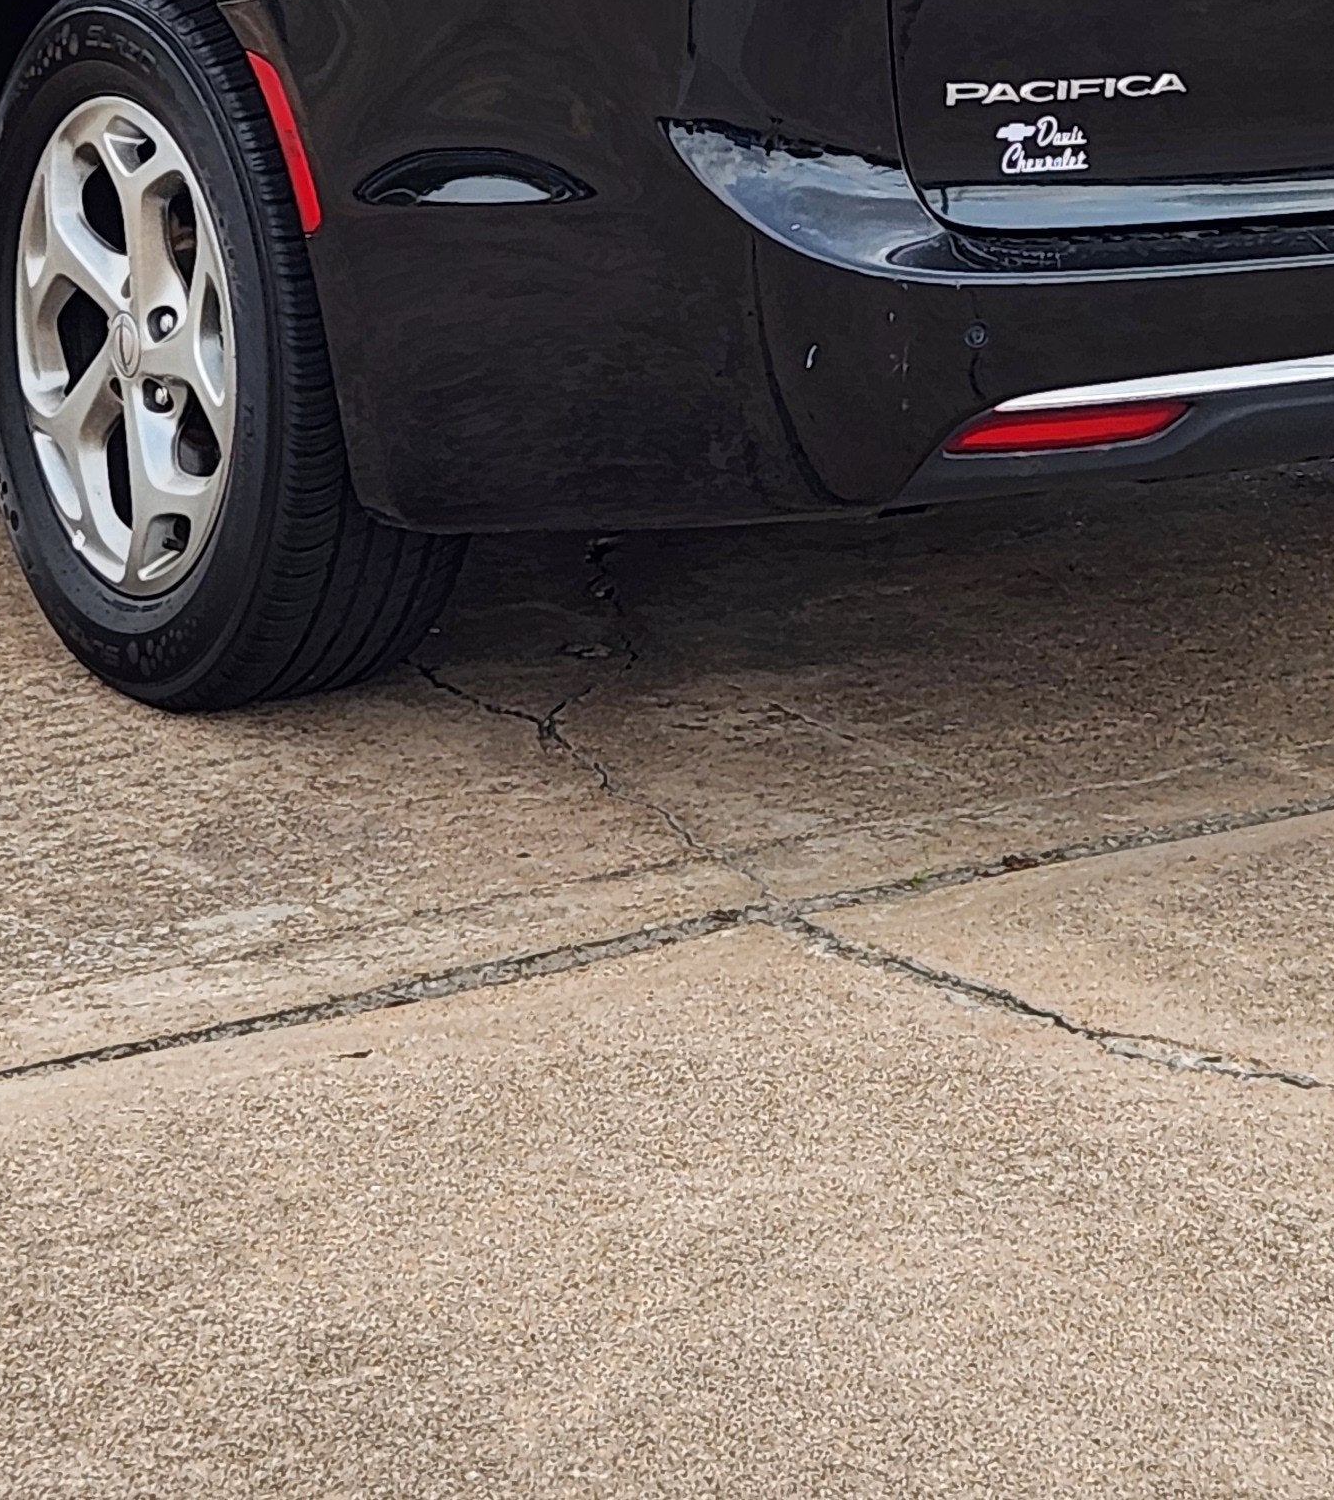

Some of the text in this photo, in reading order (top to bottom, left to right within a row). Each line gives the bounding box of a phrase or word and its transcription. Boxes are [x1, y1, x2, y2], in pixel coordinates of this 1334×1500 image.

[945, 73, 1187, 107] PACIFICA
[1036, 115, 1088, 147] Davis
[1001, 142, 1089, 174] Chevrolet
